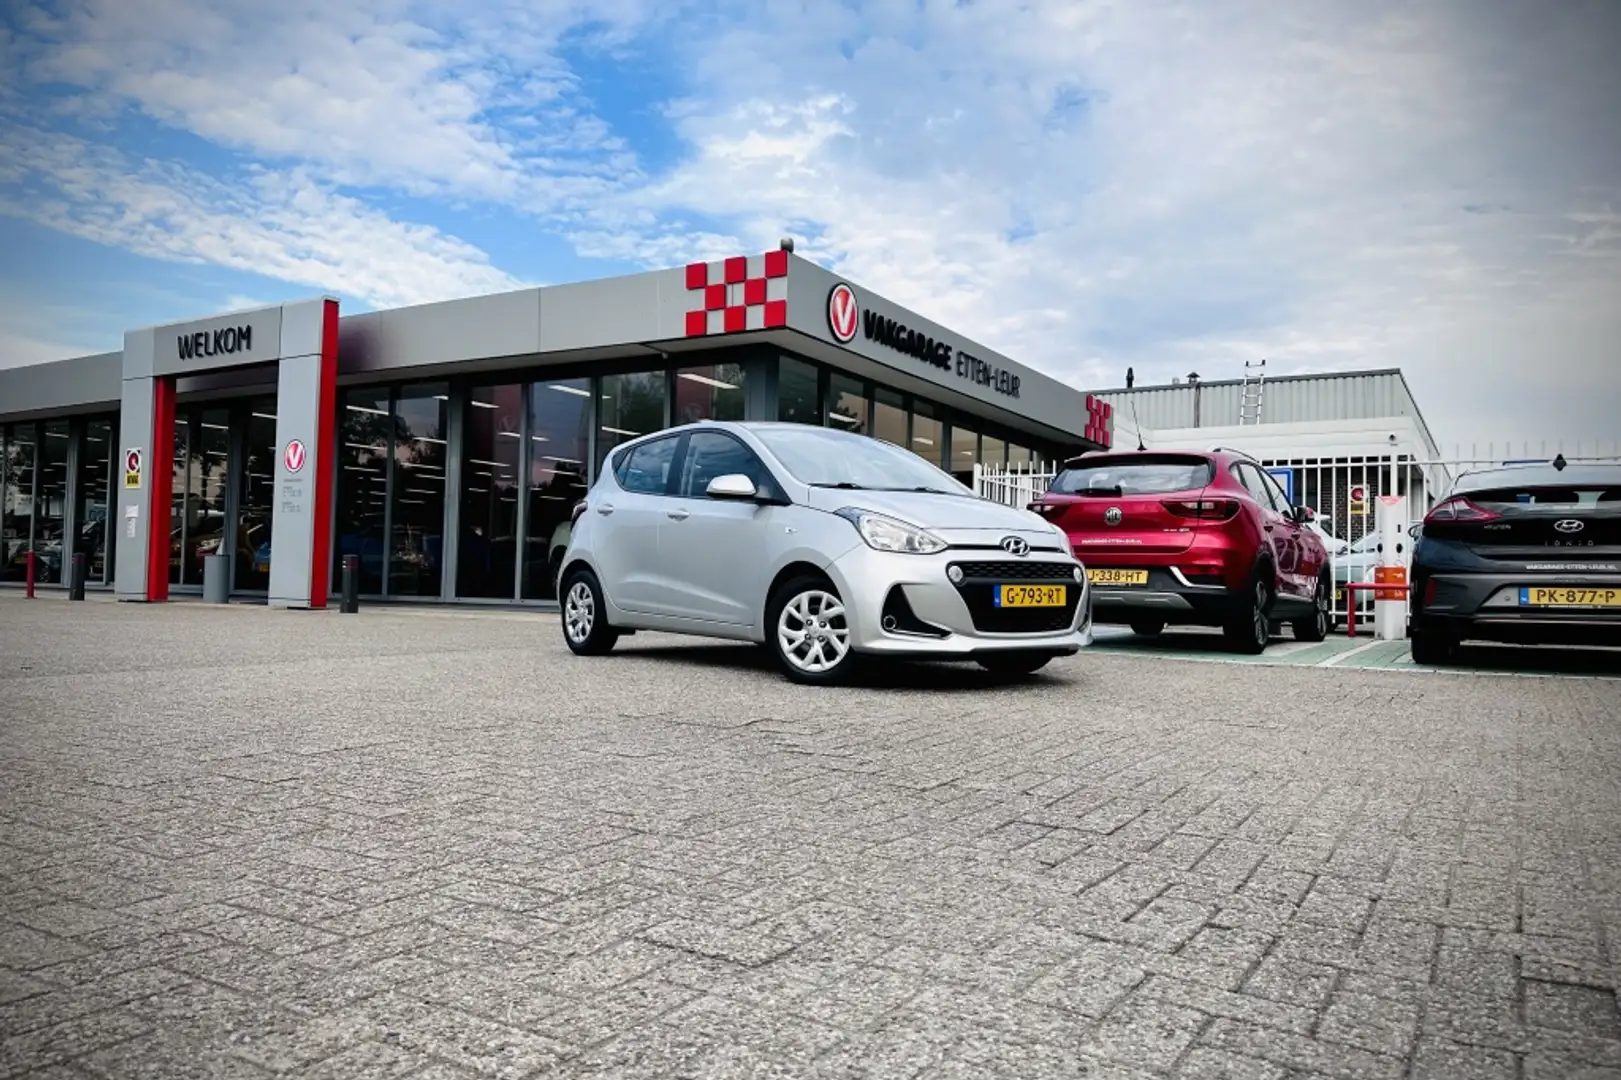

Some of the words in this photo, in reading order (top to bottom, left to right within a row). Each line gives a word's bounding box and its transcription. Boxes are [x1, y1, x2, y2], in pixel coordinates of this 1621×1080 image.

[177, 324, 252, 361] WELKOM
[863, 309, 952, 371] VAKGARAGE
[956, 351, 1021, 398] ETTEN-LEUR
[1006, 587, 1062, 604] G-793-RT
[1536, 589, 1616, 603] PK-877-P
